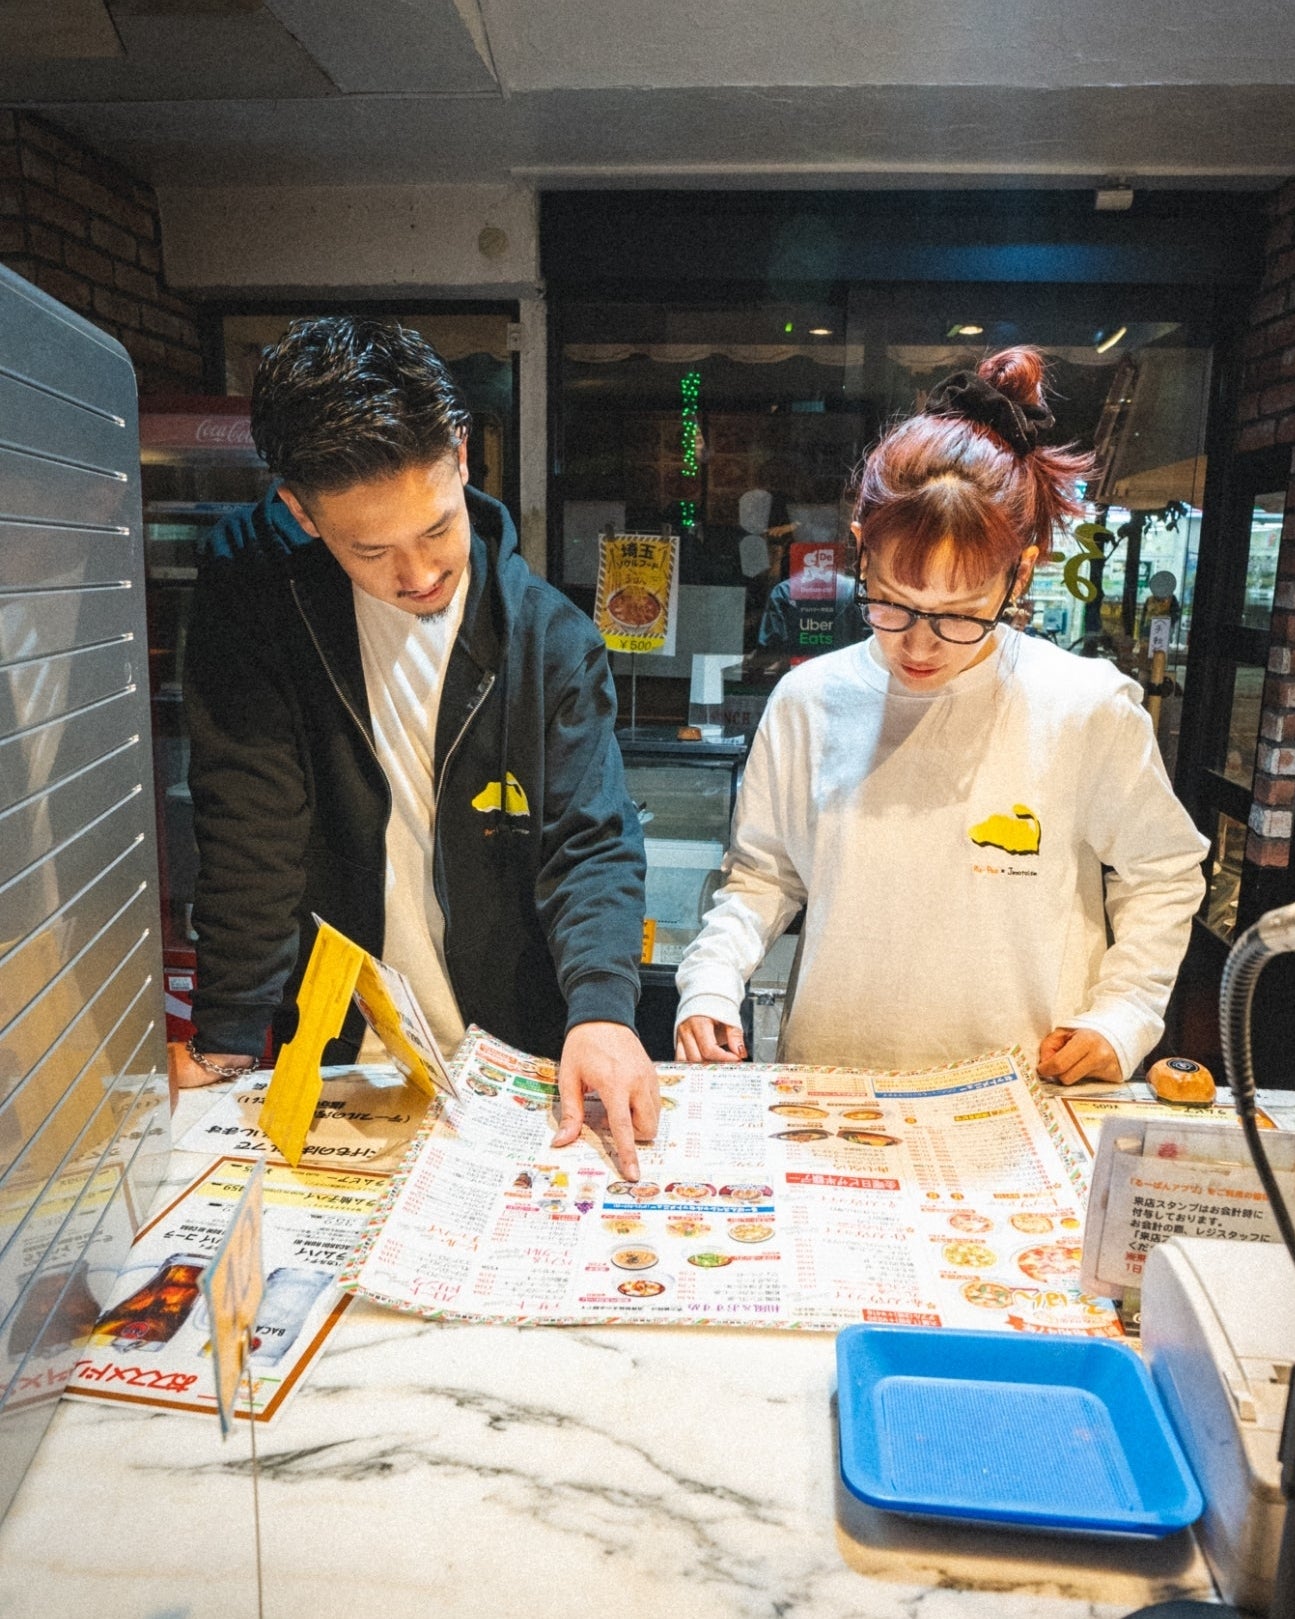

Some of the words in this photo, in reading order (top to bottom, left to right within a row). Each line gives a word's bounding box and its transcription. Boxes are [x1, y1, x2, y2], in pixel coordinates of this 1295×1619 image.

[799, 618, 834, 631] Uber
[799, 632, 833, 645] Eats
[1132, 1196, 1264, 1220] 来店スタンプはお会計時に
[1131, 1207, 1223, 1227] 付与しております。
